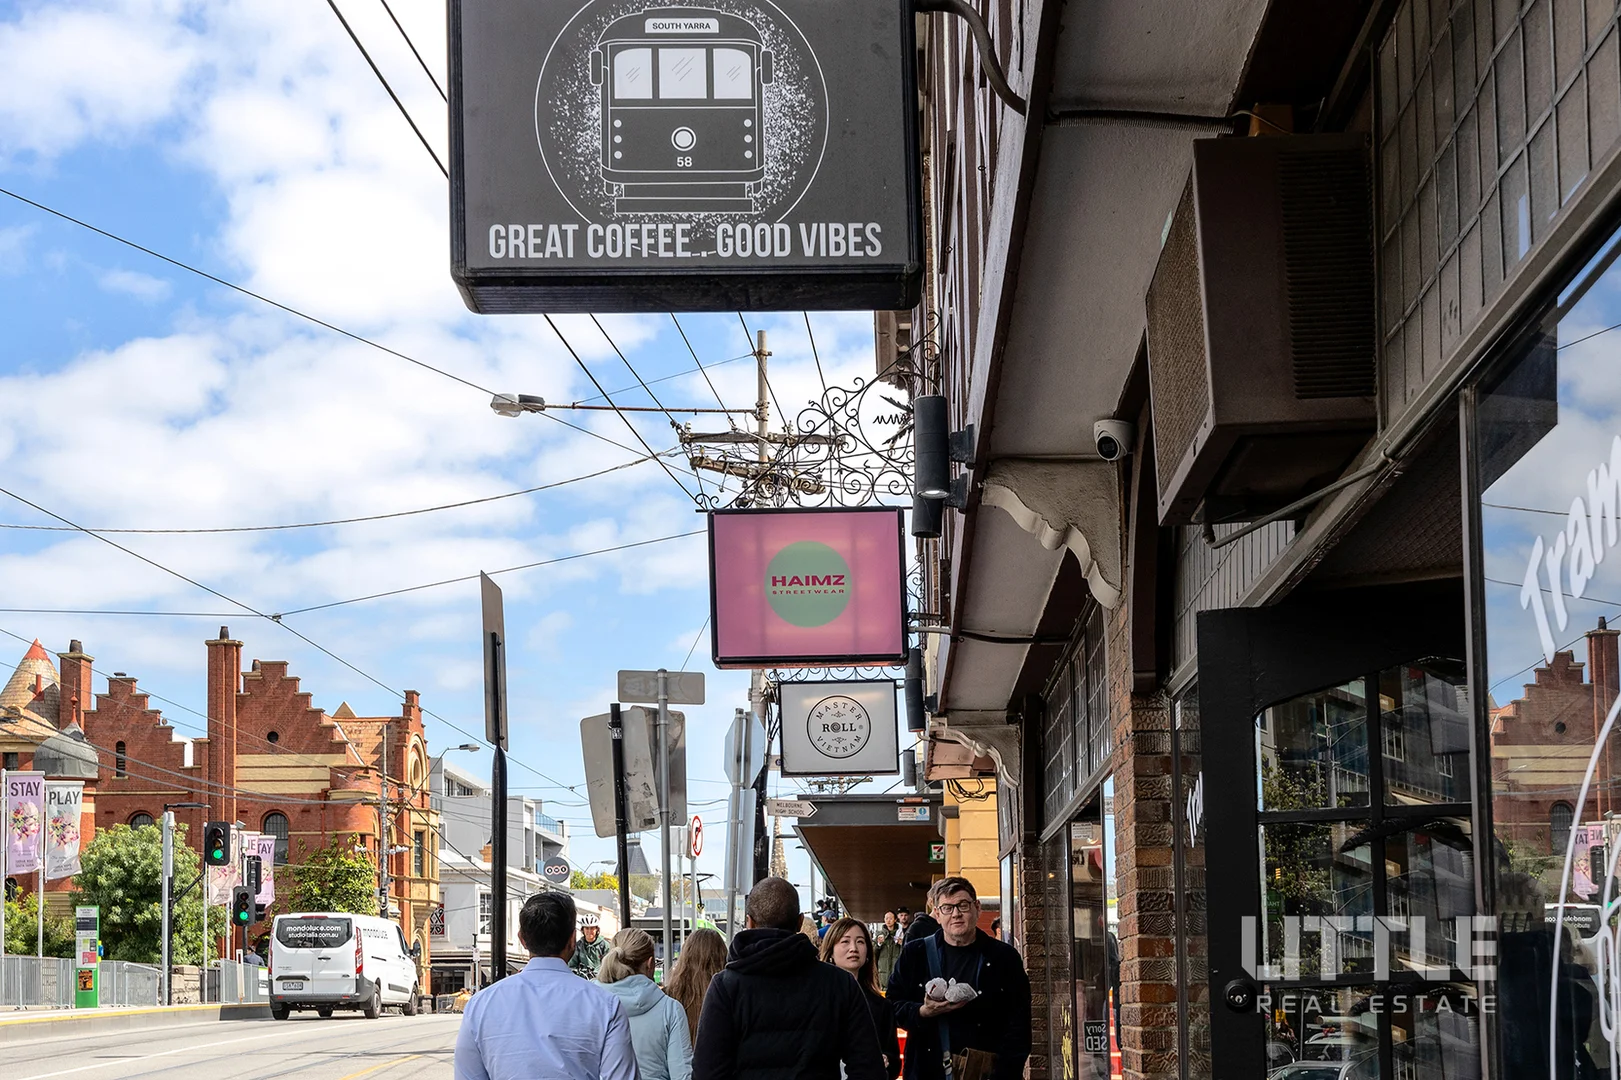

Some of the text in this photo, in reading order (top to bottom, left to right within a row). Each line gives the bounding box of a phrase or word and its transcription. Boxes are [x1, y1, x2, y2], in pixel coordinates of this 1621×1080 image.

[652, 22, 711, 30] SOUTH YARRA
[676, 156, 693, 168] 58
[488, 223, 579, 258] GREAT
[587, 223, 692, 258] COFFEE
[716, 222, 792, 258] GOOD
[799, 222, 883, 257] VIBES
[771, 574, 845, 587] HAIMZ
[816, 701, 863, 720] MASTER
[822, 722, 857, 733] ROLL
[816, 735, 862, 753] VIETNAM
[10, 782, 40, 797] STAY
[49, 791, 80, 805] PLAY
[257, 843, 273, 854] TAY
[286, 924, 342, 932] mondoluce.com
